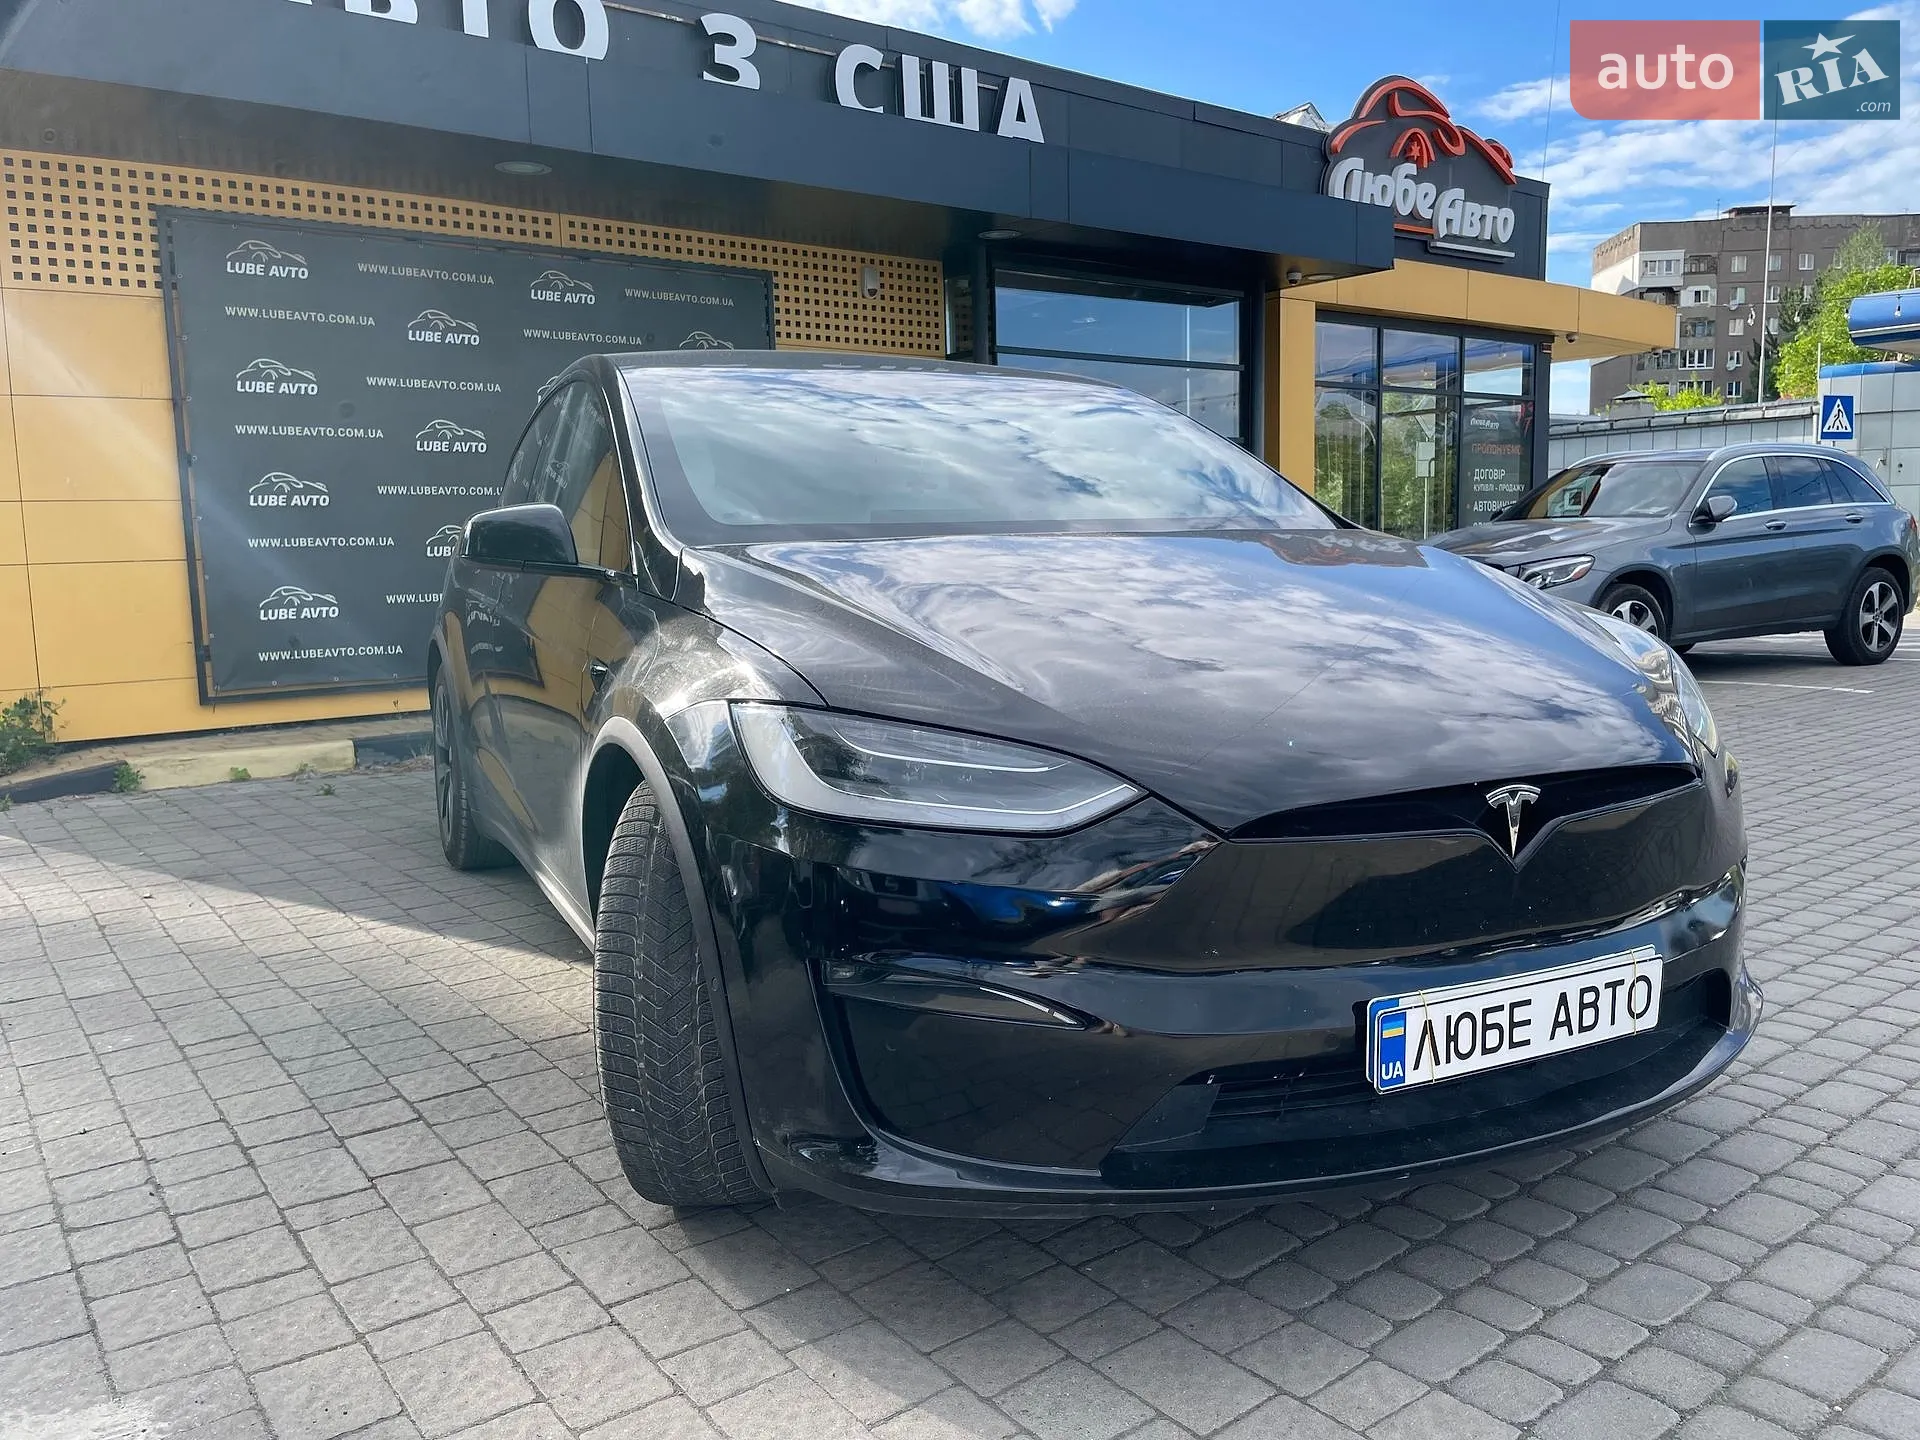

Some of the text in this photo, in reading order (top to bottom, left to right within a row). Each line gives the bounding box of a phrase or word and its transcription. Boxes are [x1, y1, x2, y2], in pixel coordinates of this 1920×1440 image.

[834, 44, 1045, 143] США
[227, 259, 309, 280] LUBE AVTO
[357, 262, 495, 285] WWW.LUBEAVTO.COM.UA
[530, 288, 596, 305] LUBE AVTO
[624, 288, 734, 307] WWW.LUBEAVTO.COM.UA
[225, 306, 376, 326] WWW.LUBEAVTO.COM.UA
[408, 329, 480, 345] LUBE AVTO
[523, 329, 642, 346] WWW.LUBEAVTO.COM.UA
[236, 379, 318, 395] LUBE AVTO
[366, 376, 501, 393] WWW.LUBEAVTO.COM.UA
[235, 424, 384, 439] WWW.LUBEAVTO.COM.UA
[416, 439, 487, 453] LUBE AVTO
[1473, 469, 1506, 481] ДОГОВІР
[377, 485, 503, 496] WWW.LUBEAVTO.COM.U
[249, 495, 330, 507] LUBE AVTO
[248, 536, 395, 548] WWW.LUBEAVTO.COM.UA
[426, 546, 455, 557] LUB
[259, 606, 339, 621] LUBE AVTO
[258, 645, 403, 662] WWW.LUBEAVTO.COM.UA
[1413, 974, 1653, 1071] ЛЮБЕ АВТО
[1381, 1060, 1404, 1081] UA
